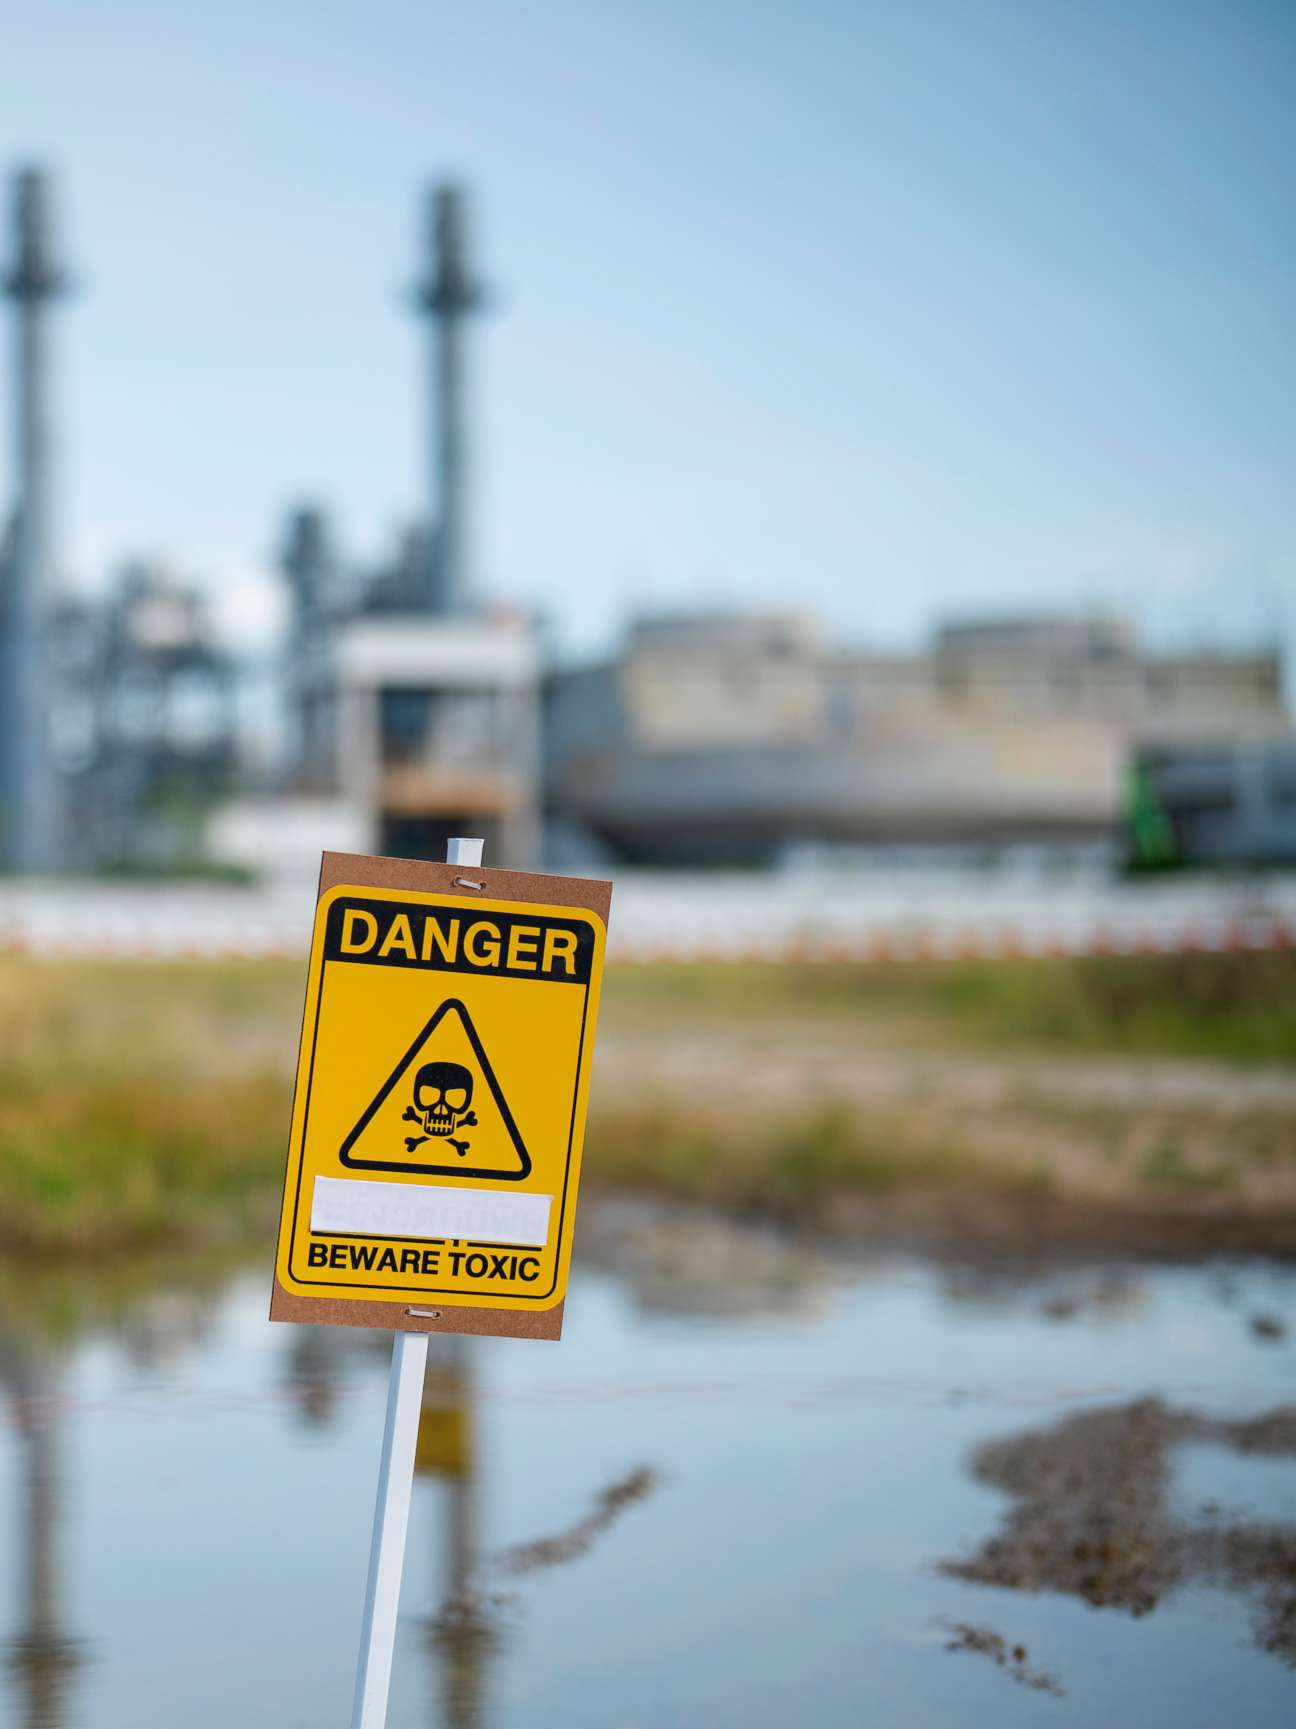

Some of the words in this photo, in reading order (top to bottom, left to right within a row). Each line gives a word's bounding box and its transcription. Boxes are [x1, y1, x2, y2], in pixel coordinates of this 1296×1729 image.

[340, 909, 578, 975] DANGER
[308, 1243, 440, 1275] BEWARE
[448, 1252, 540, 1282] TOXIC
